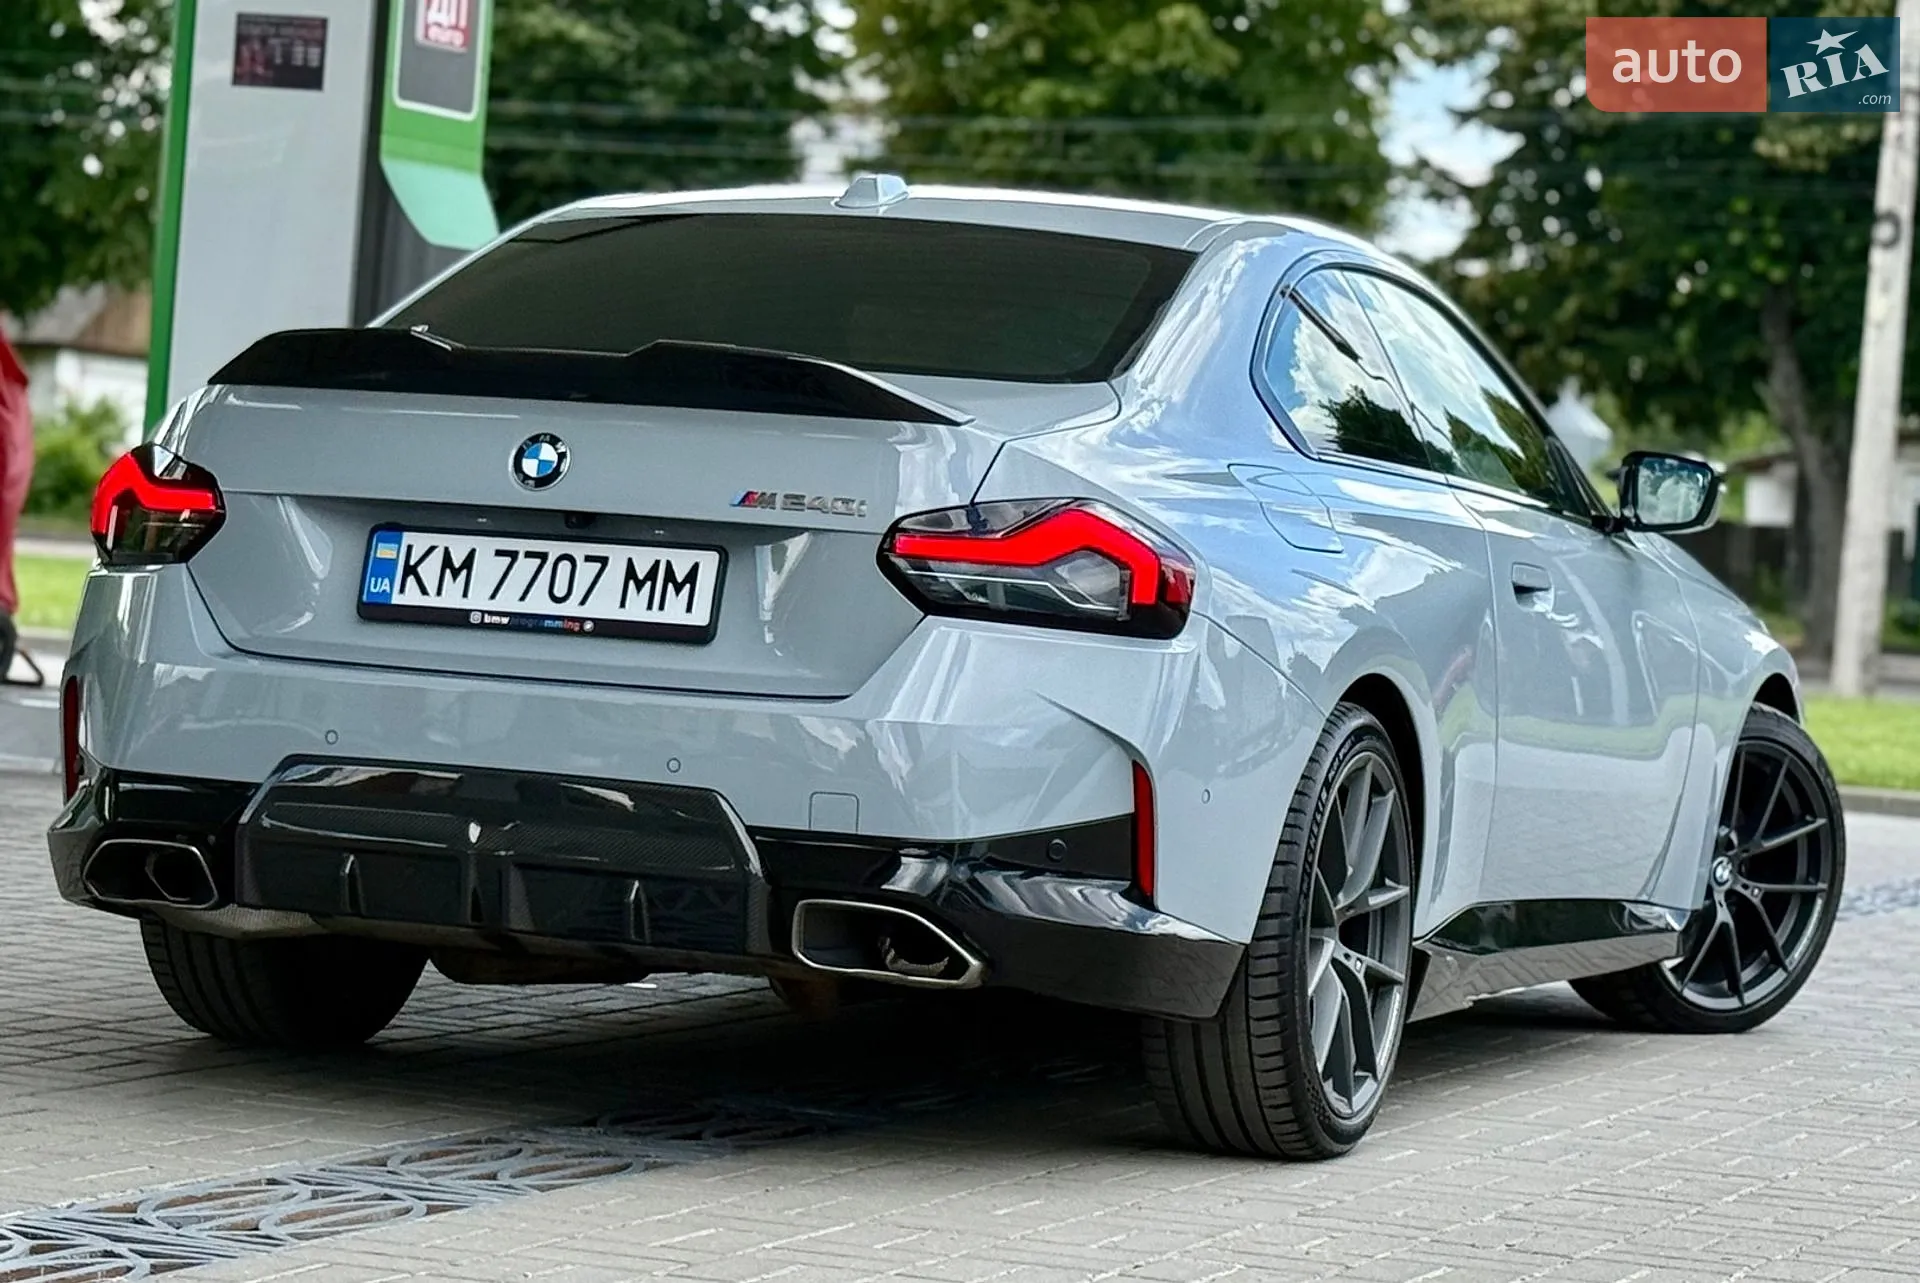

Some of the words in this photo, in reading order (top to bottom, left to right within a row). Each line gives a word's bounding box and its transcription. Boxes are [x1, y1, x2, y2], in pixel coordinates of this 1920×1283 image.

[370, 577, 391, 594] UA
[398, 544, 477, 600] KM
[488, 549, 610, 606] 7707
[618, 557, 700, 614] MM
